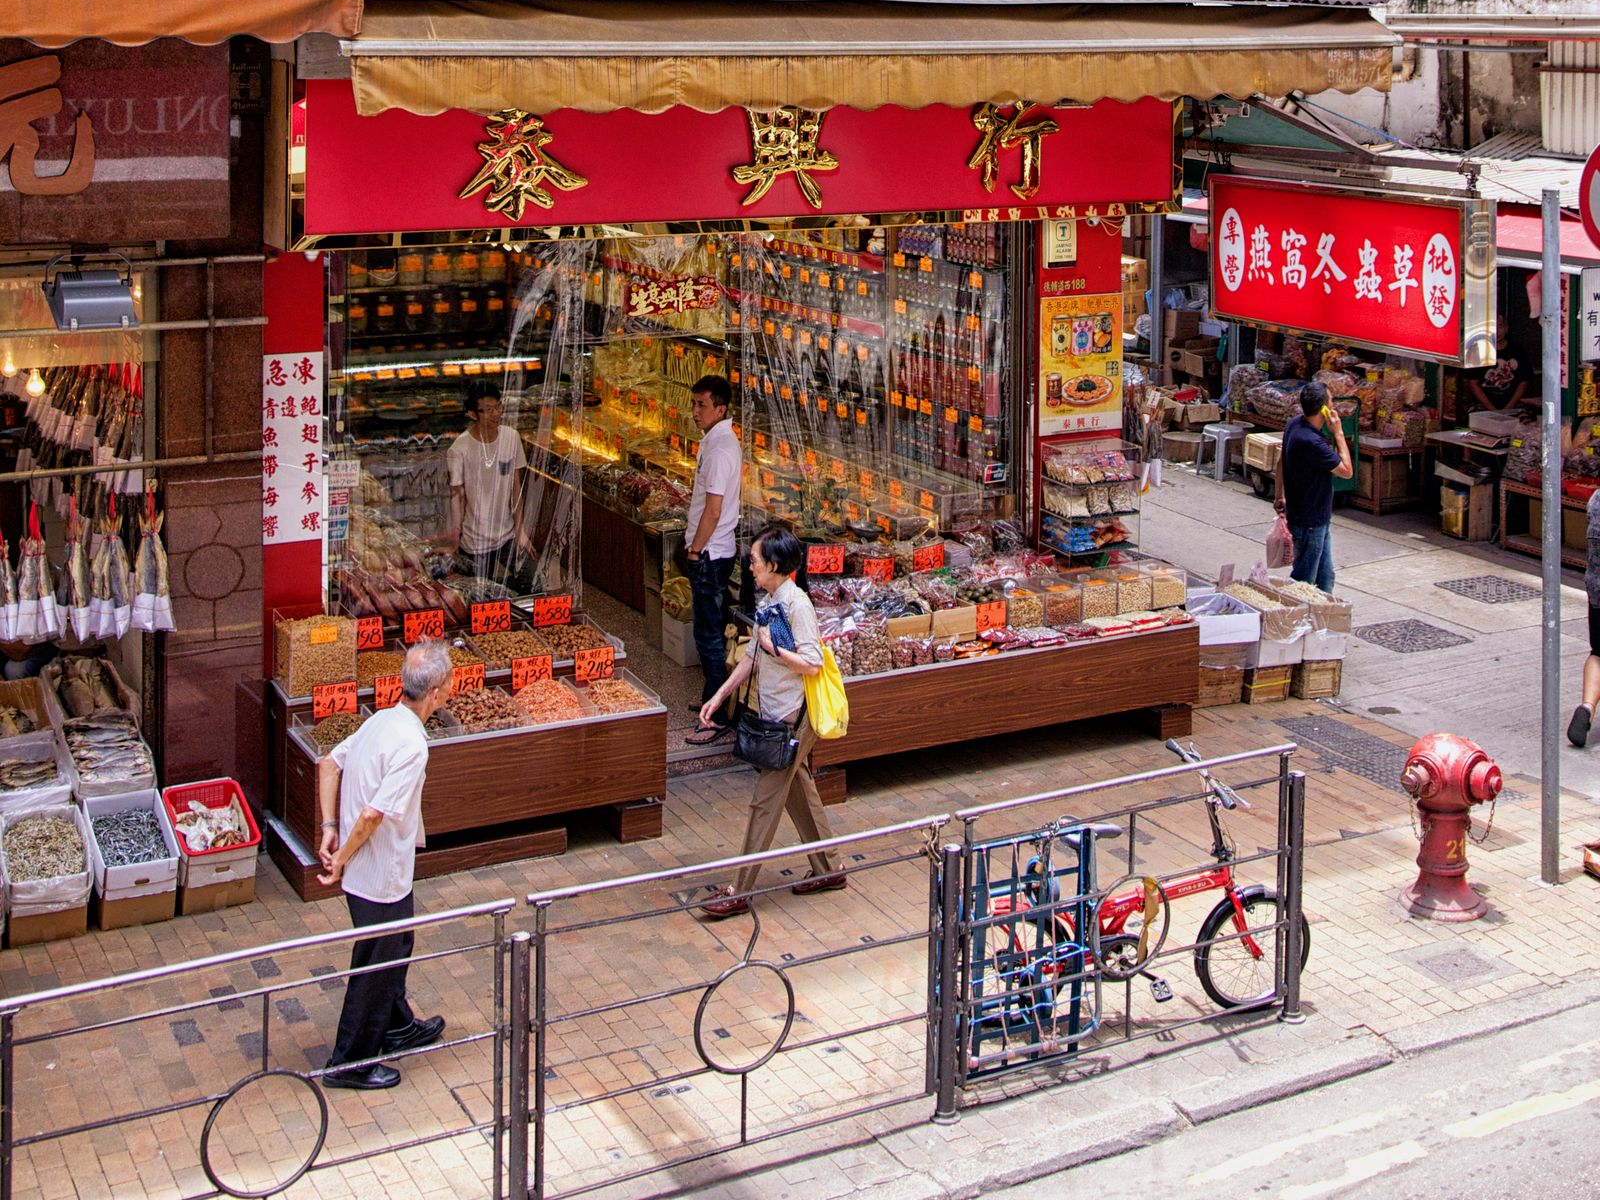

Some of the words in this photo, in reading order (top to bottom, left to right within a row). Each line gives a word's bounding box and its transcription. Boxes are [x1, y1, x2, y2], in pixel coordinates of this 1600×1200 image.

[1223, 215, 1241, 284] 專營
[1248, 223, 1419, 308] 燕窩冬蟲草
[1427, 243, 1454, 319] 批發
[265, 357, 317, 387] 急凍
